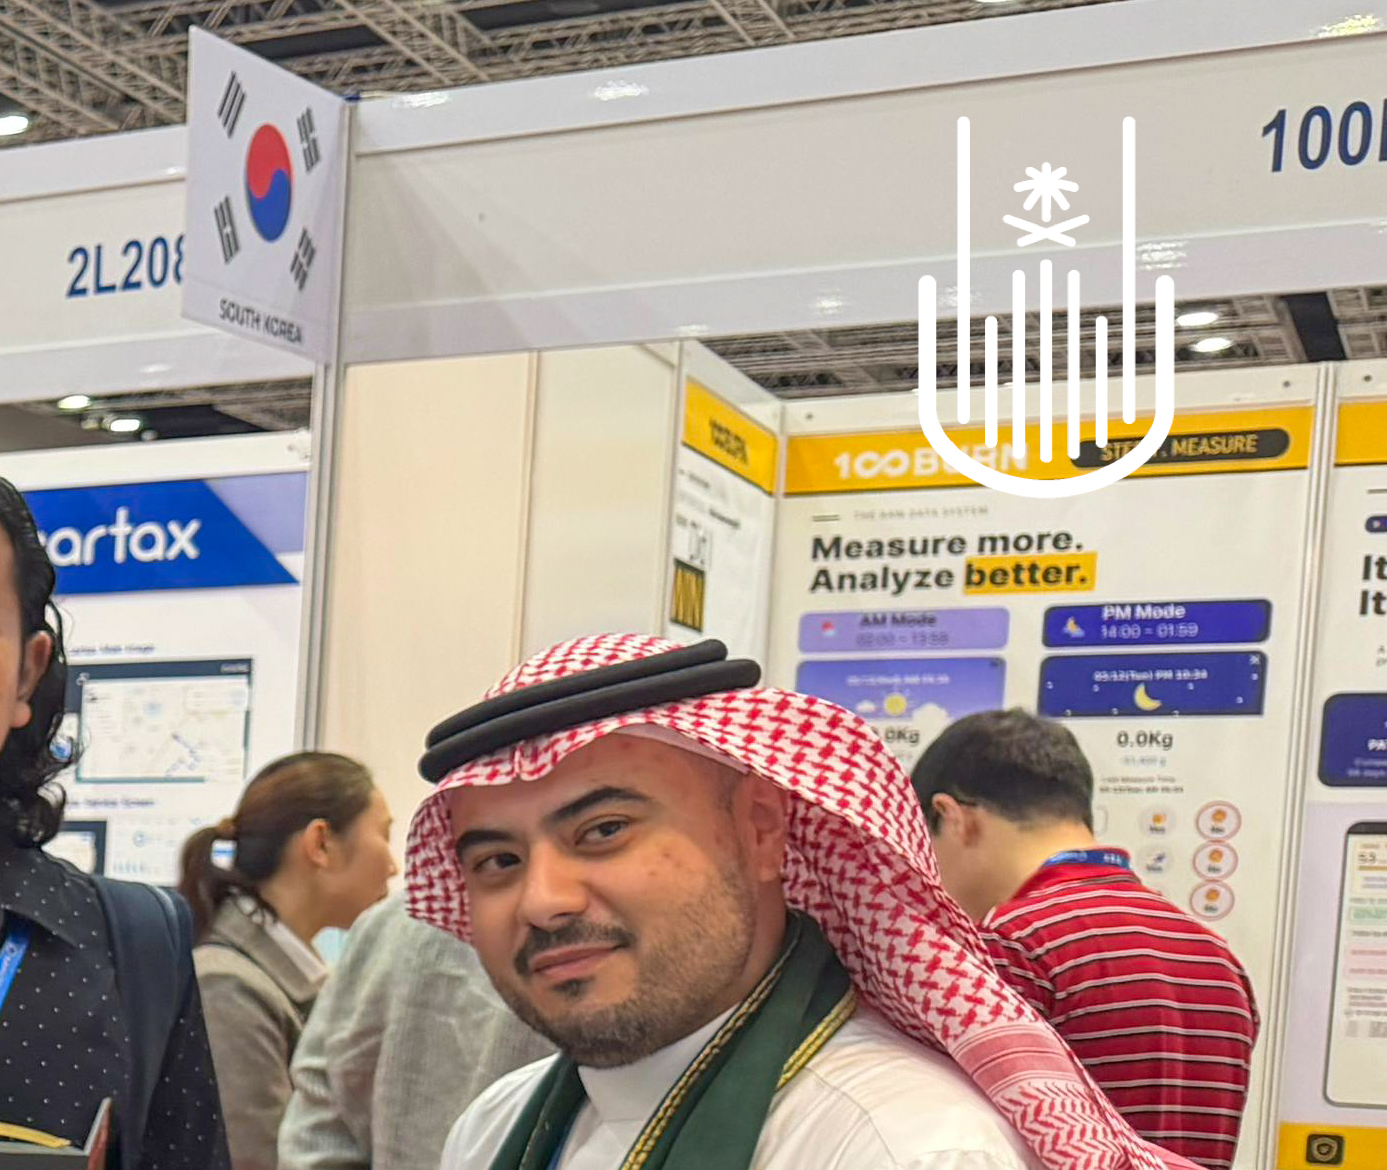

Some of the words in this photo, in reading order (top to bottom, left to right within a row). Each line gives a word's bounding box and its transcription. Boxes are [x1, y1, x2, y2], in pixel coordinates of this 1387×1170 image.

[219, 297, 260, 332] SOUTH
[261, 312, 303, 346] KOREA
[1170, 434, 1259, 457] MEASURE
[39, 506, 202, 567] artax
[811, 533, 967, 560] Measure
[978, 529, 1084, 552] more.
[809, 564, 955, 597] Analyze
[965, 562, 1088, 590] better.
[1101, 604, 1132, 620] PM
[1135, 603, 1187, 620] Mode
[1116, 729, 1174, 751] 0.0Kg
